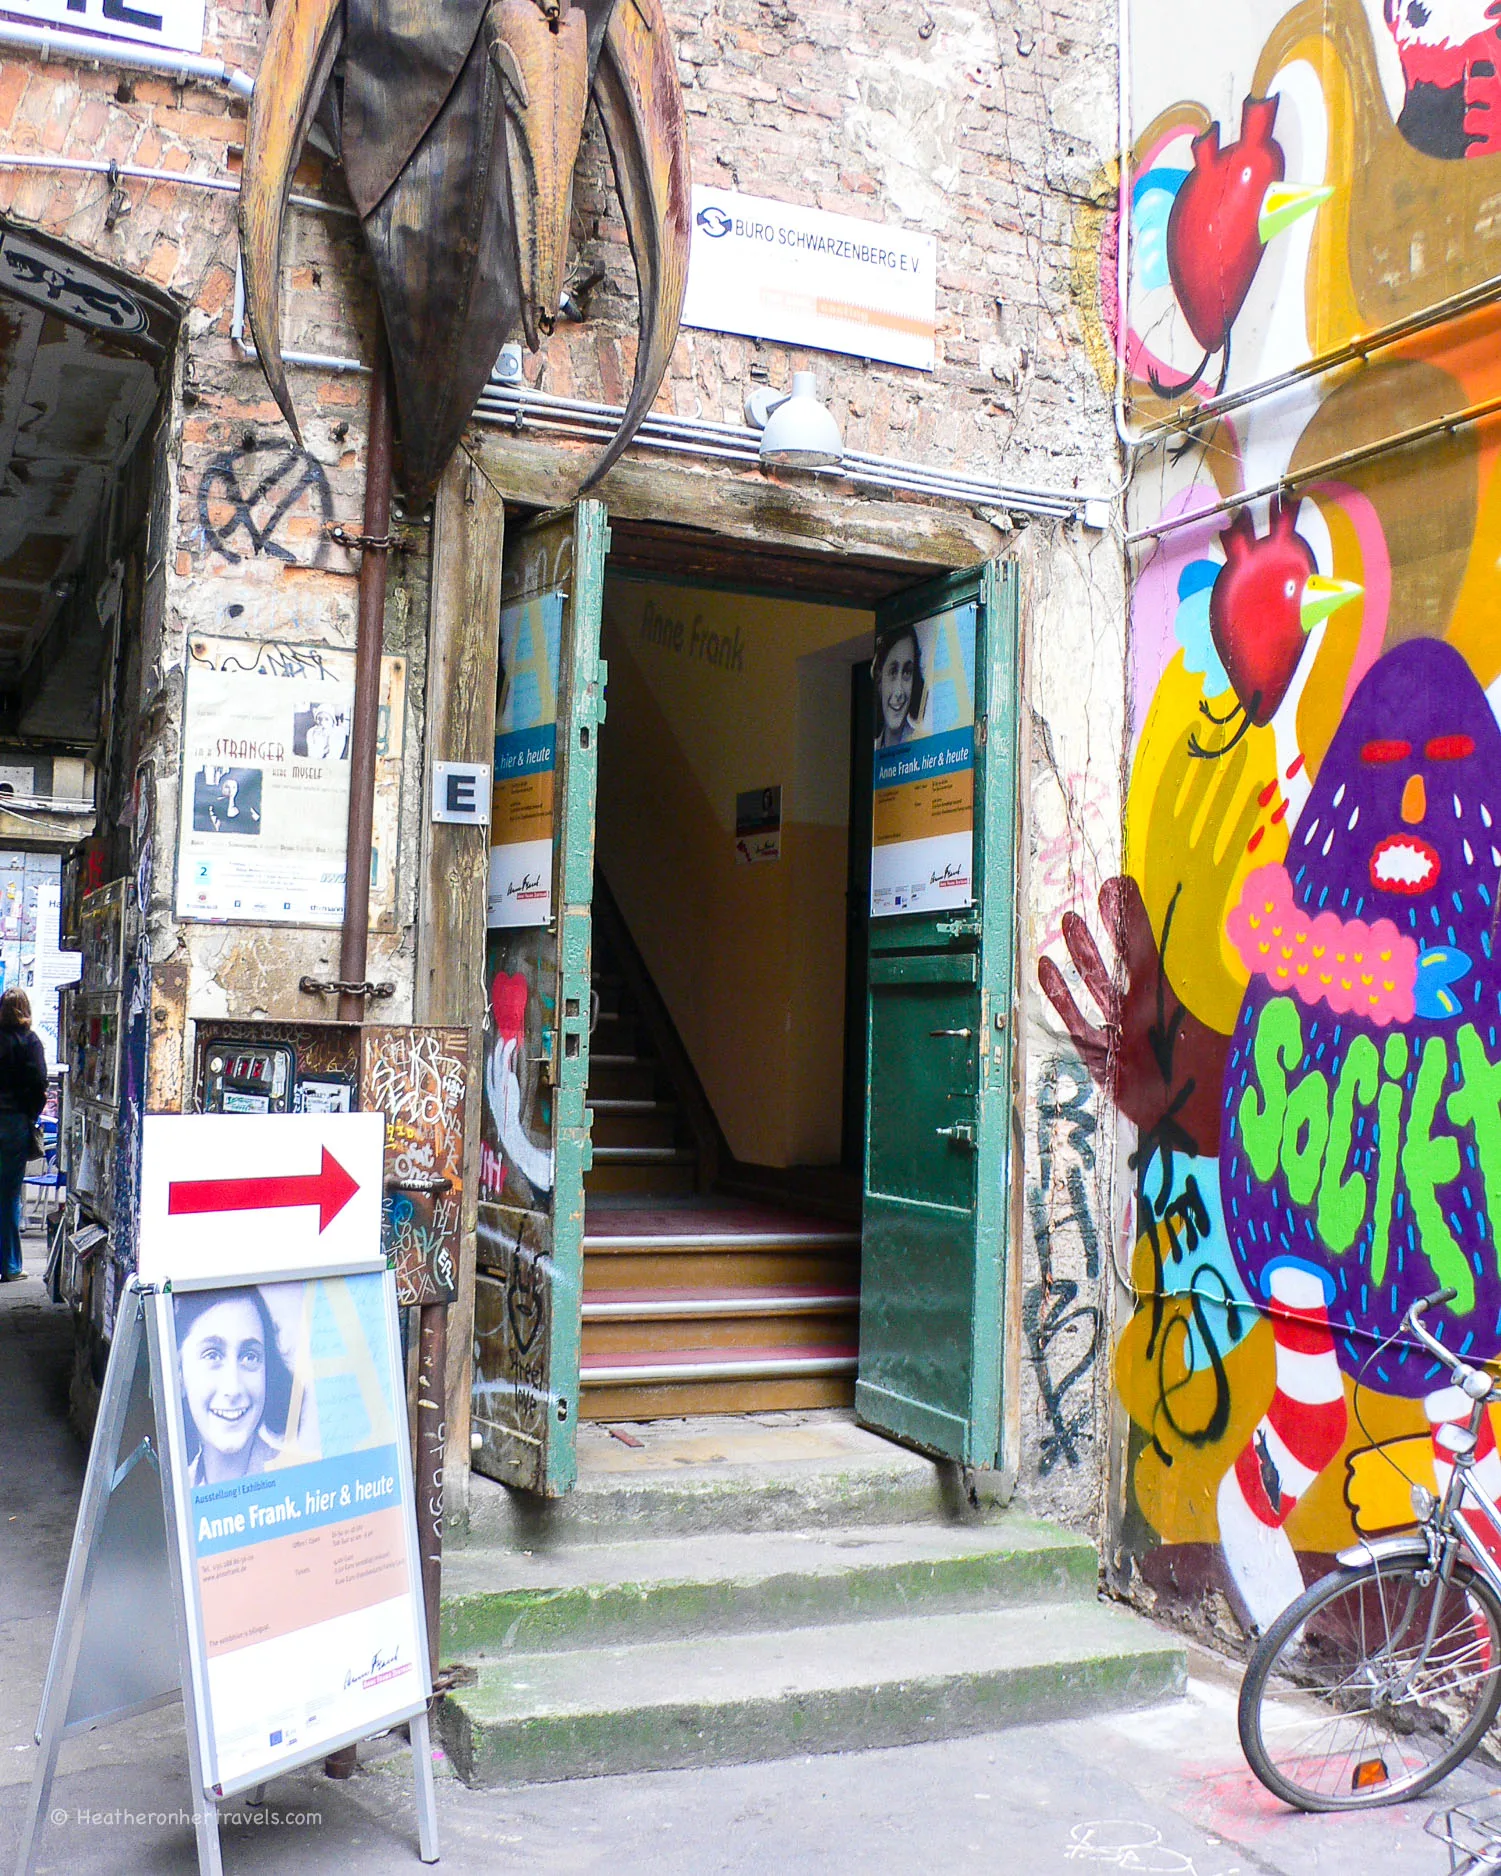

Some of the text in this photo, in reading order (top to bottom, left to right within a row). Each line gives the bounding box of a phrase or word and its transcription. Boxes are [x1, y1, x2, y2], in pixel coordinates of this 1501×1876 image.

[778, 228, 896, 268] SCHWARZENBERG
[641, 600, 745, 673] Anne Frank
[216, 738, 285, 762] STRANGER
[500, 746, 551, 769] hier & heute
[879, 765, 897, 780] Anne
[898, 758, 920, 776] Frank.
[921, 753, 937, 770] hier
[937, 751, 944, 766] &
[945, 746, 969, 765] heute
[292, 766, 323, 780] MYSELF
[447, 774, 476, 812] E
[195, 1480, 277, 1504] Ausstellung Exhibition
[198, 1475, 395, 1542] Anne Frank. hier & heute
